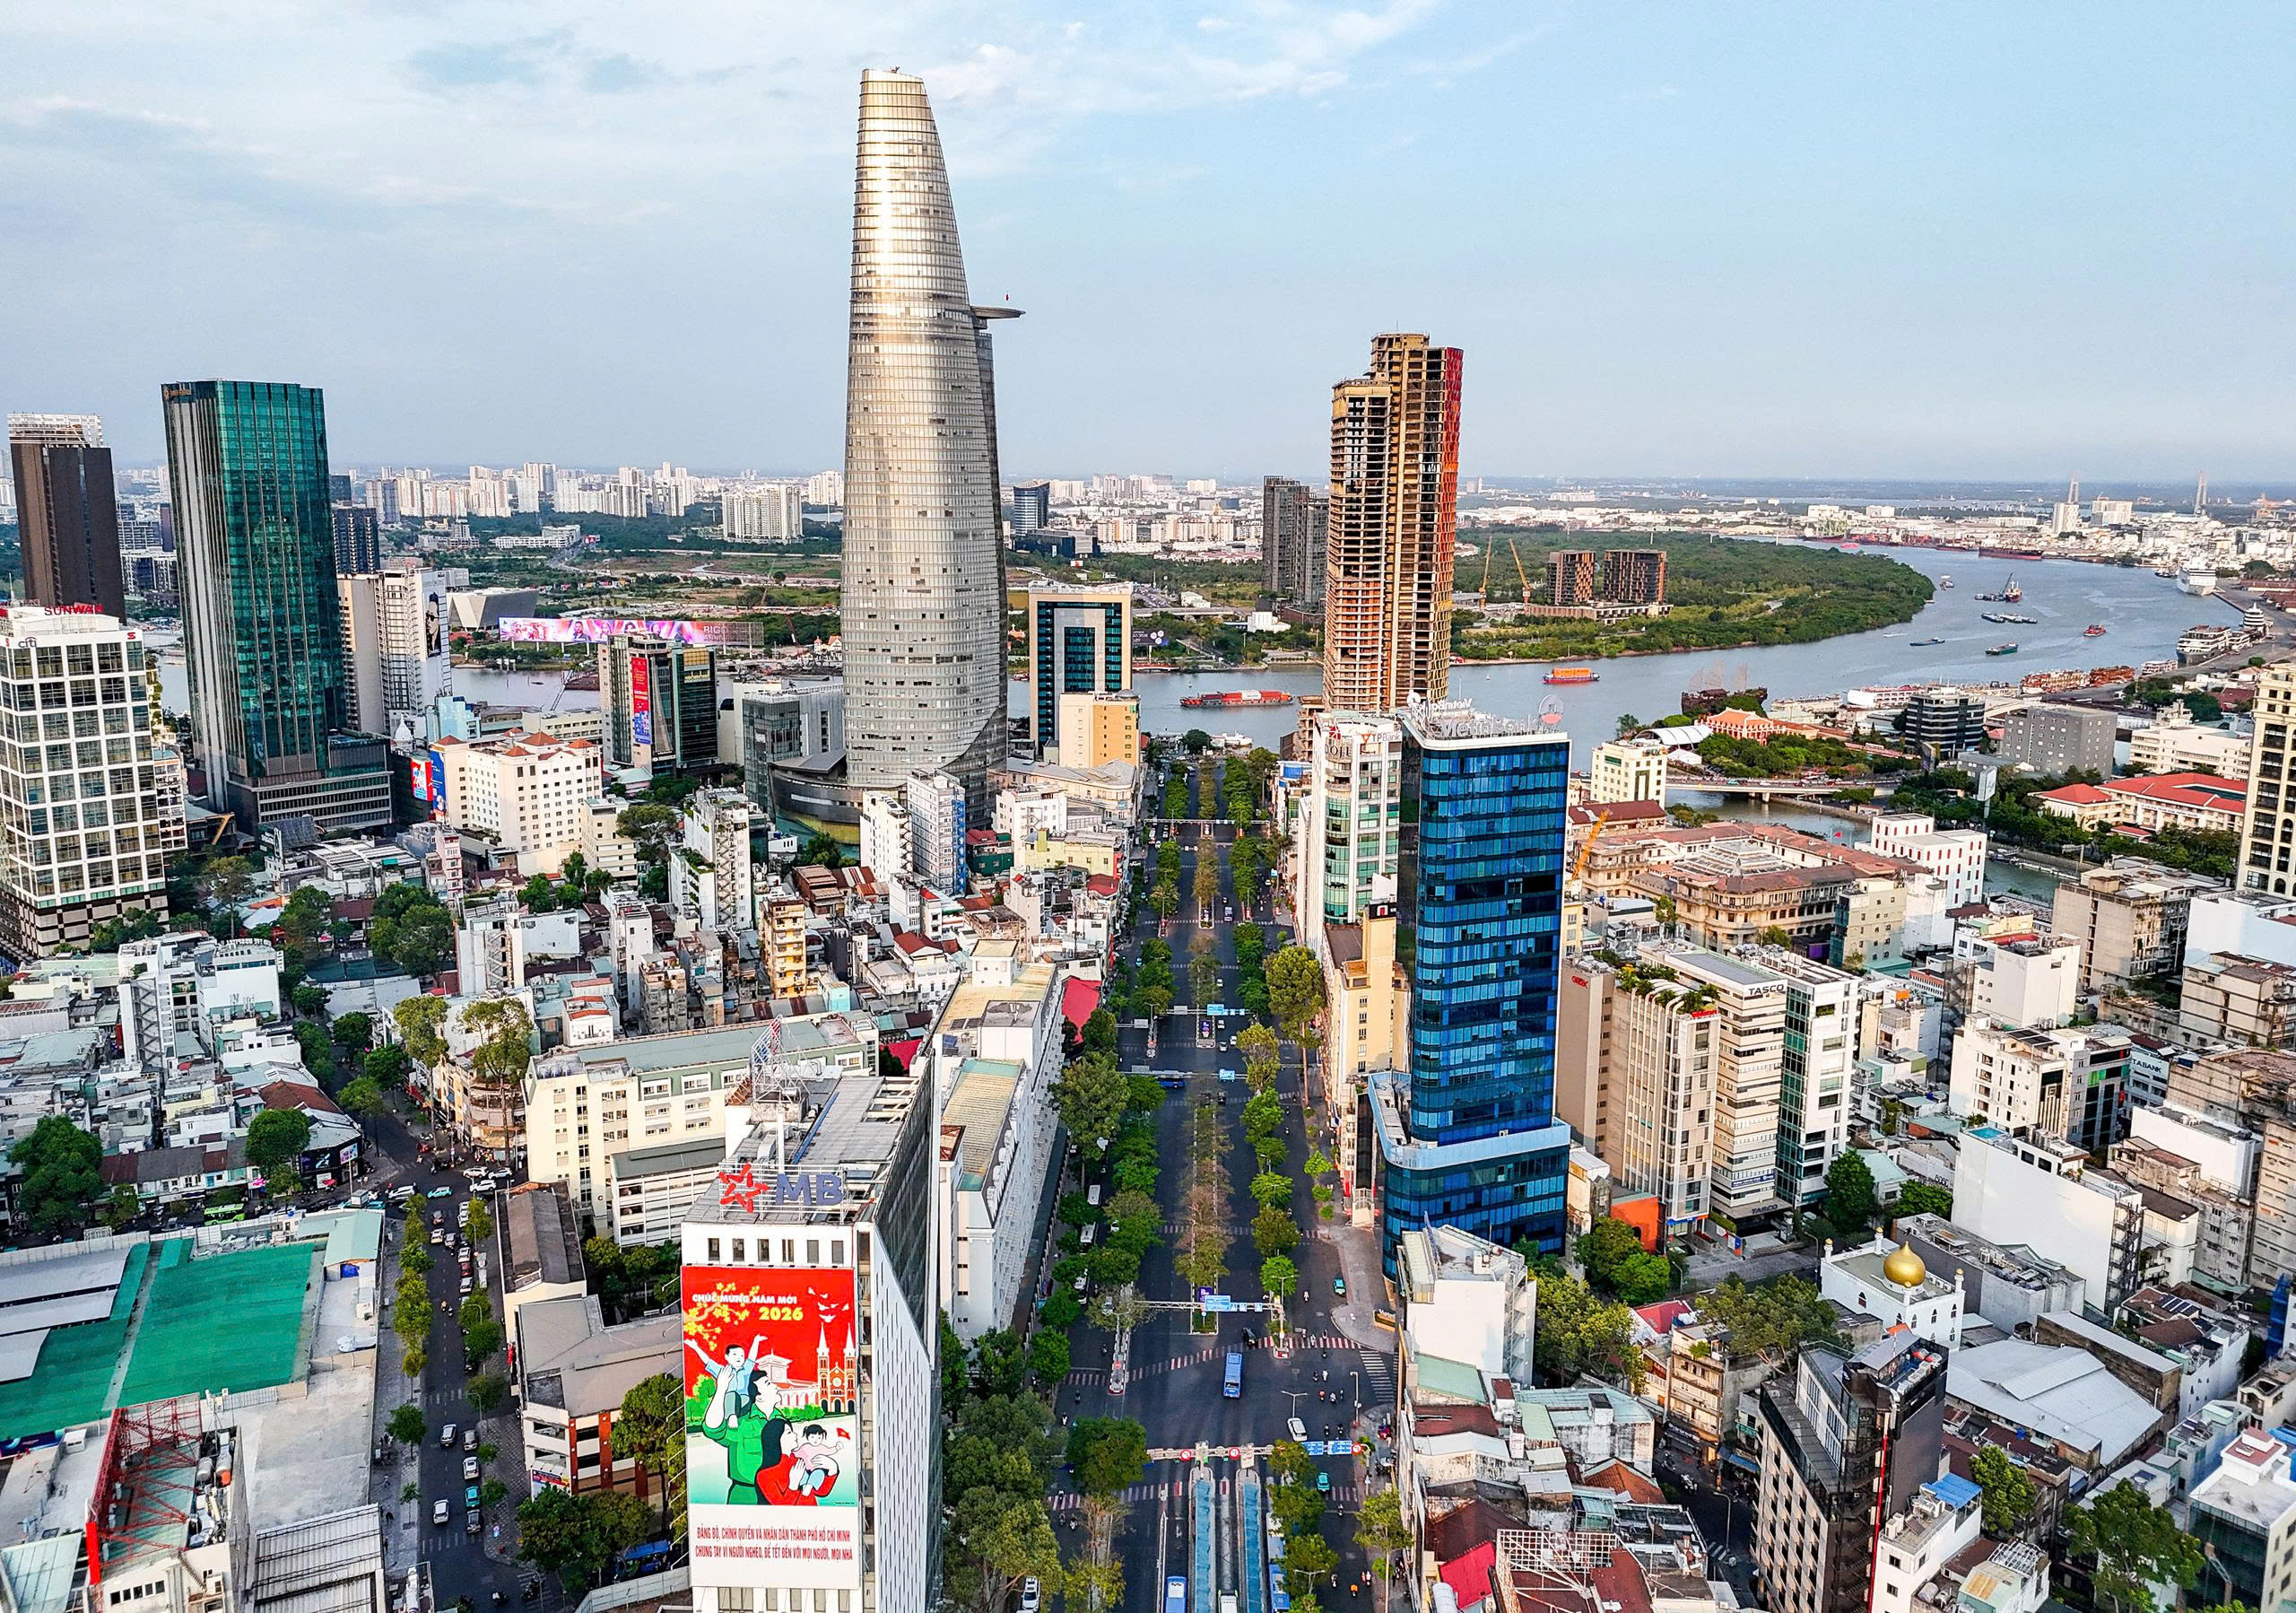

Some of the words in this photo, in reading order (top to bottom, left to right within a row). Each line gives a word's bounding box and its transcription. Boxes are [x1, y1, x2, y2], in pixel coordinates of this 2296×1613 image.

[18, 636, 37, 649] citi
[1371, 732, 1400, 742] TPBank
[1748, 983, 1785, 996] TASCO
[2130, 1059, 2161, 1074] TABANK
[775, 1173, 844, 1207] MB
[1751, 1204, 1779, 1215] TASCO
[778, 1295, 797, 1304] MỚI
[759, 1306, 804, 1321] 2026
[837, 1530, 850, 1542] MINH
[695, 1545, 712, 1557] CHUNG
[713, 1546, 722, 1558] TAY
